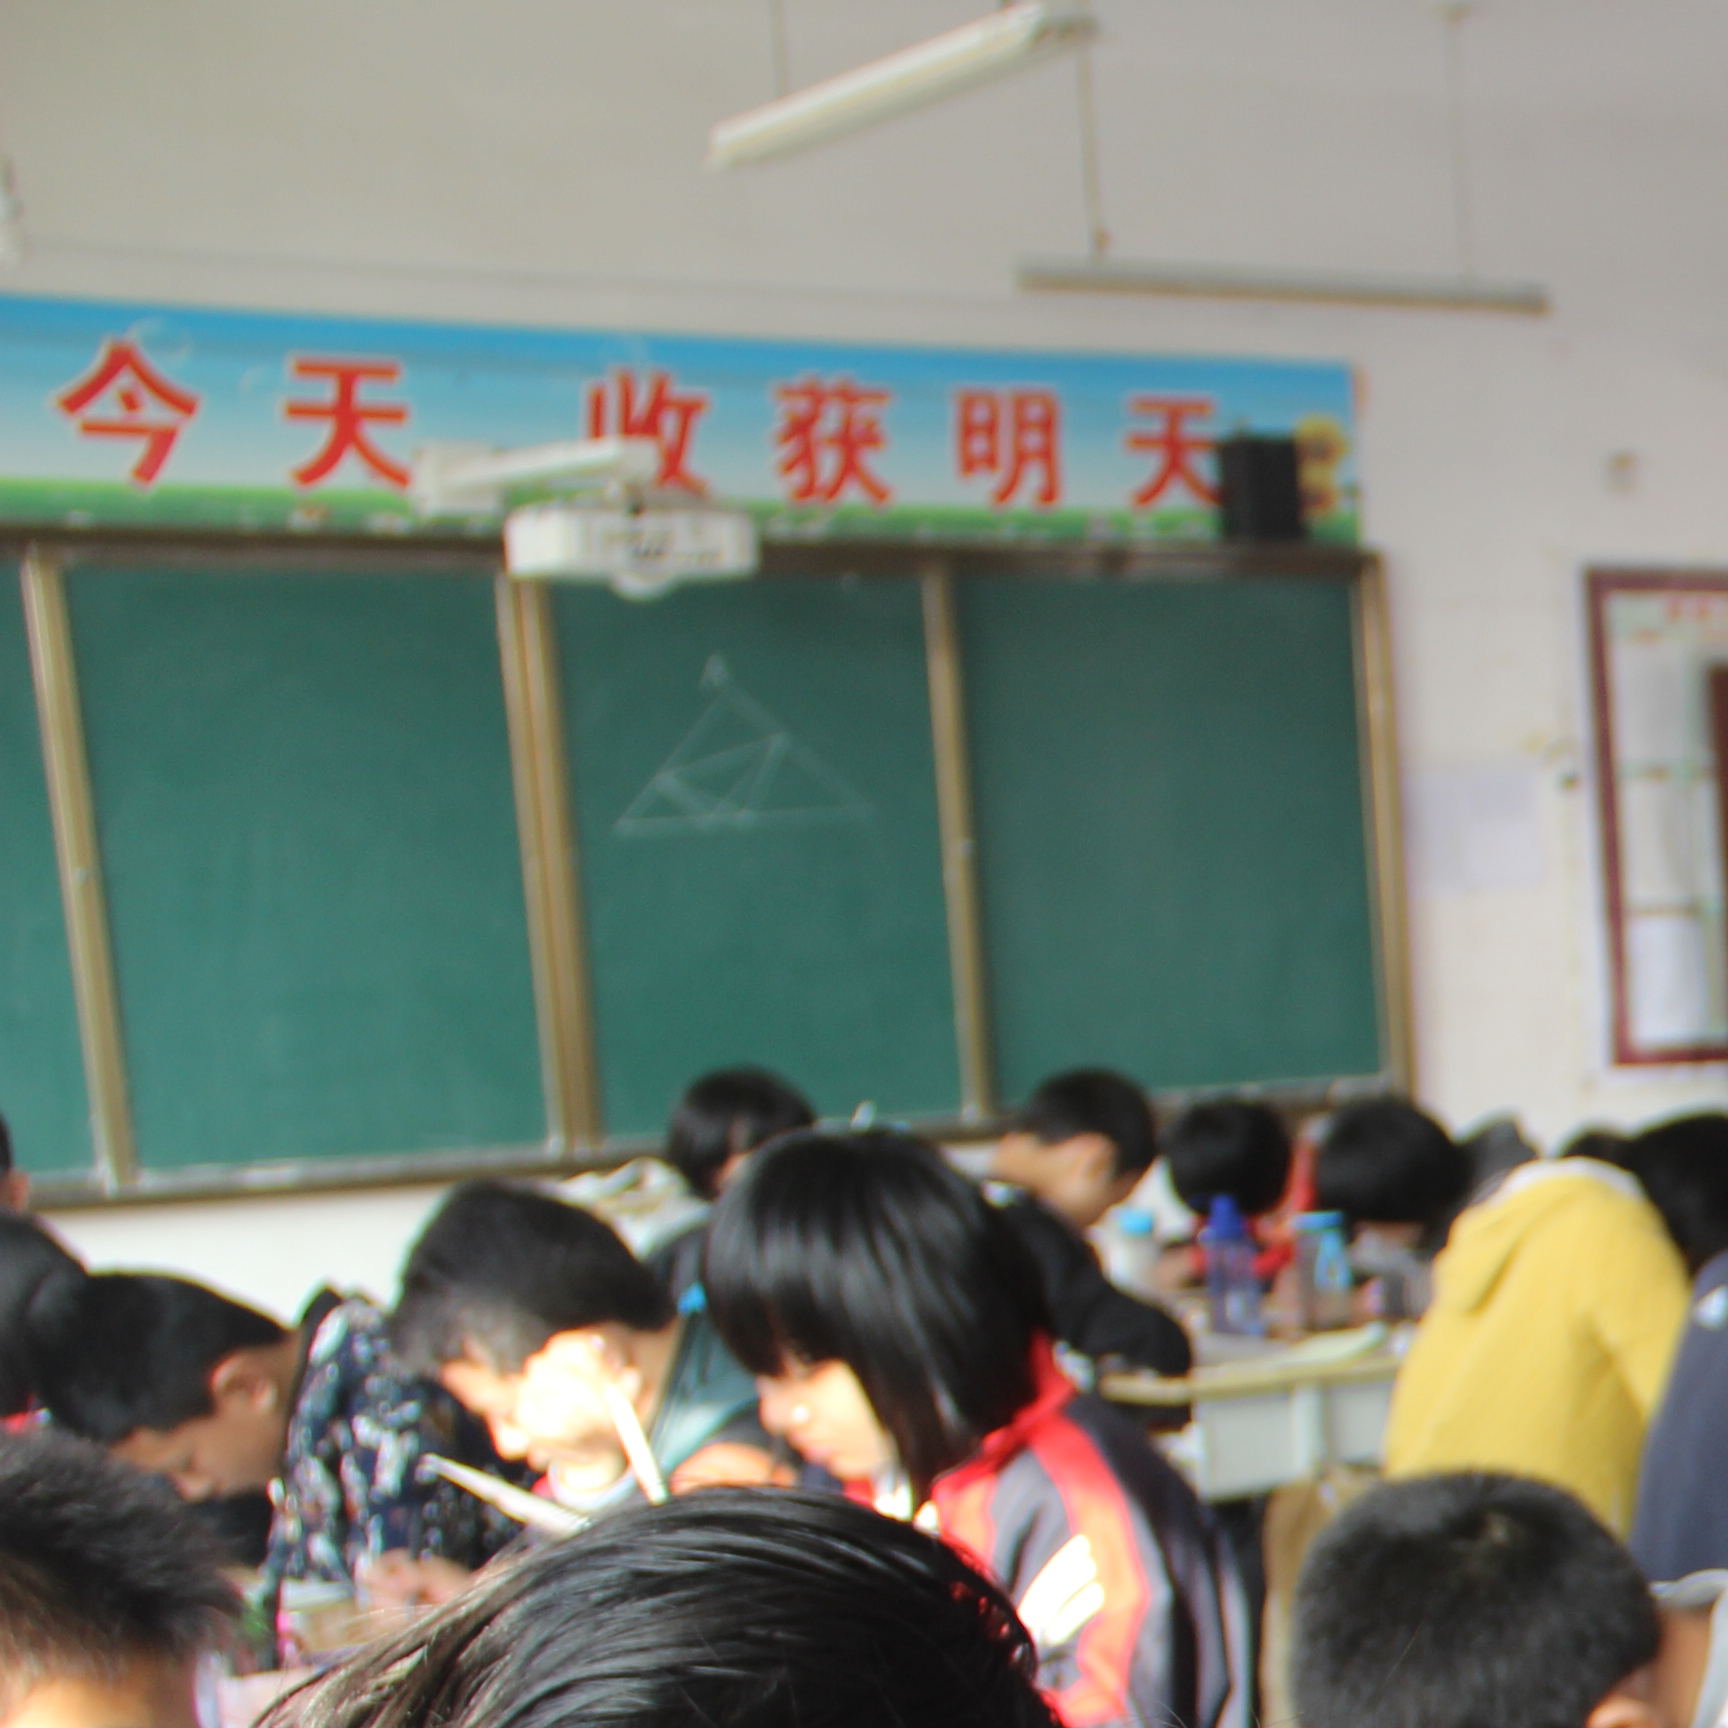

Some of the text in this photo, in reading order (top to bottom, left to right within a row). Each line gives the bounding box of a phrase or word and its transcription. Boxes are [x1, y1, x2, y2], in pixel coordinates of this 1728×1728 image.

[55, 338, 1222, 508] 今天 收获明天
